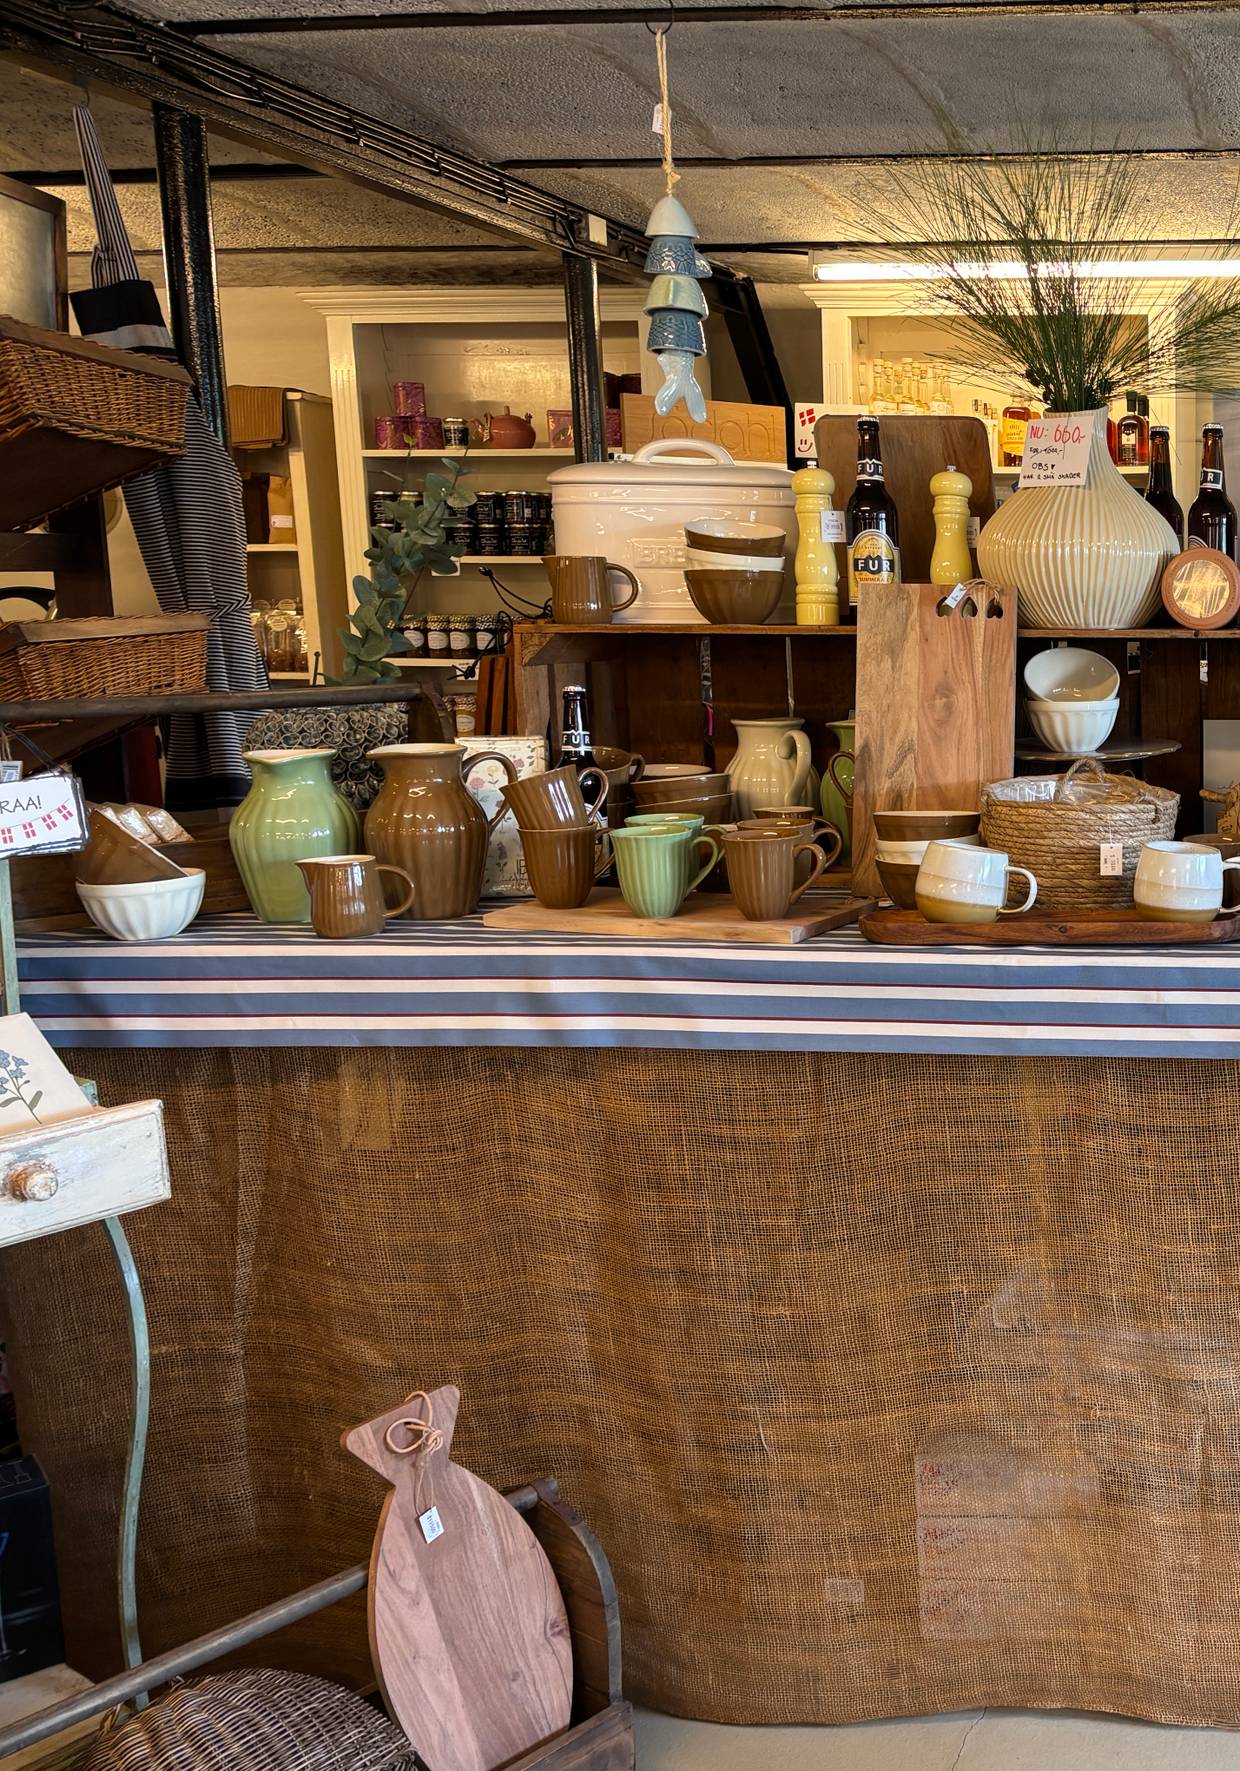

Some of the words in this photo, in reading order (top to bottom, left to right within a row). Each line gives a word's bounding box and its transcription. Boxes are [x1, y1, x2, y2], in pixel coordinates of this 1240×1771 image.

[857, 462, 884, 474] FUR
[857, 559, 891, 572] FUR
[562, 733, 591, 745] FUR
